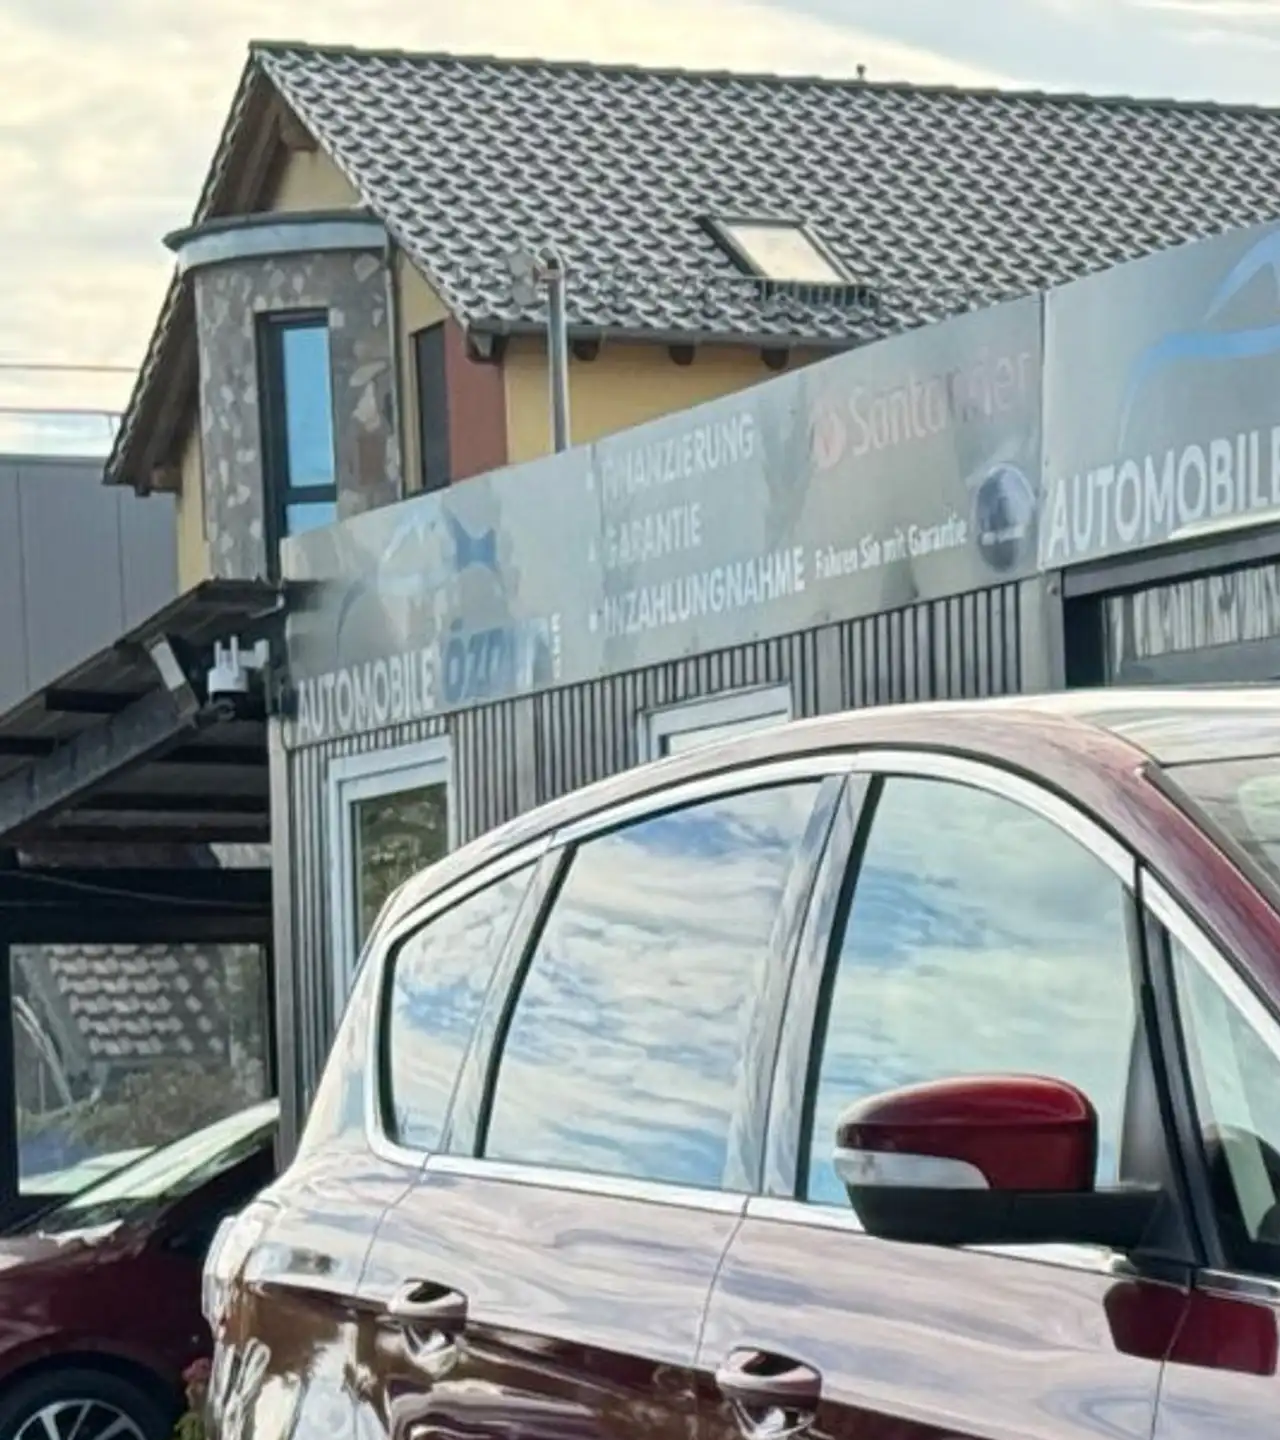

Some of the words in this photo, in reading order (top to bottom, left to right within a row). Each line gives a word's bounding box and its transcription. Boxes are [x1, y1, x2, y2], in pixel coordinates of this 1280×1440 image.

[815, 544, 859, 580] Fahren
[860, 532, 882, 569] Sie
[883, 524, 906, 563] mit
[908, 510, 967, 556] Garantie
[296, 647, 437, 738] AUTOMOBILE
